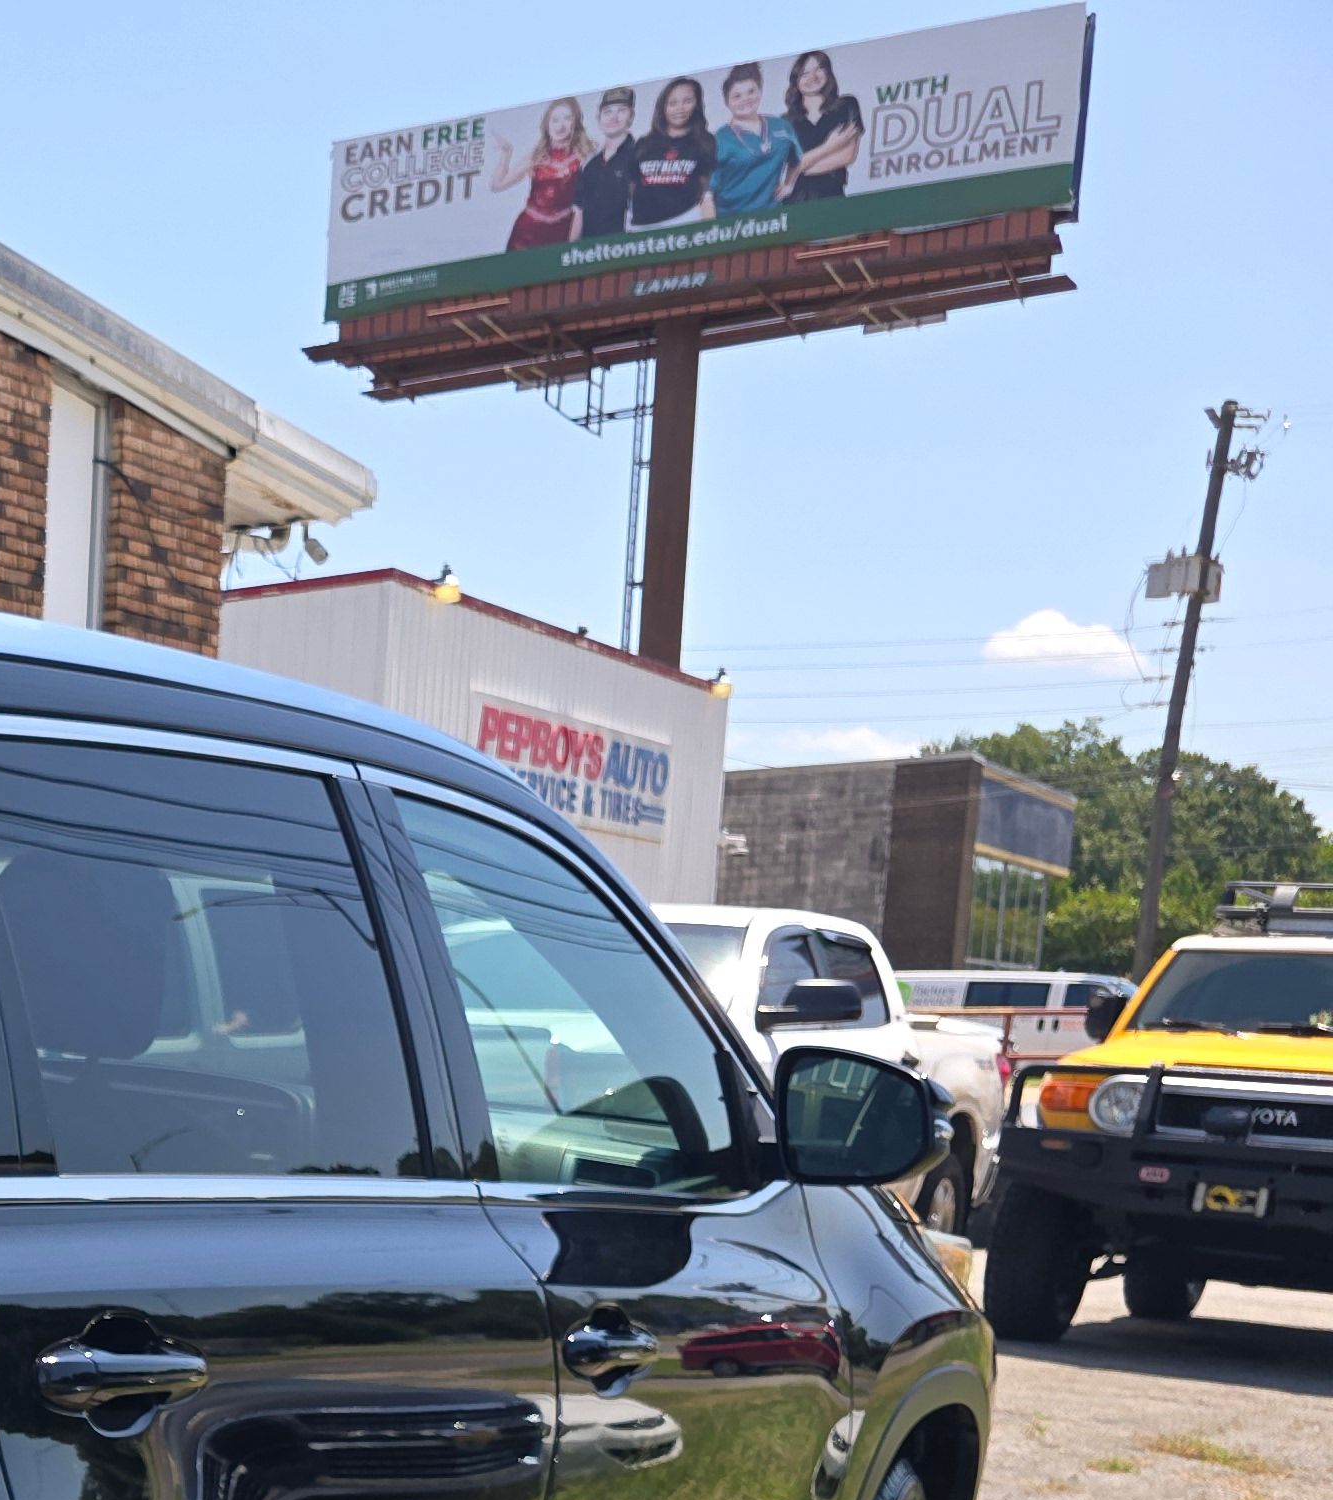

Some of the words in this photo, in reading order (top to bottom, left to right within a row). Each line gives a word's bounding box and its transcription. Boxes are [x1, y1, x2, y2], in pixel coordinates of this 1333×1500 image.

[875, 73, 950, 105] WITH
[345, 131, 414, 166] EARN
[422, 117, 485, 149] FREE
[869, 79, 1061, 158] DUAL
[340, 141, 485, 193] COLLEGE
[868, 131, 1059, 180] ENROLLMENT
[340, 169, 480, 223] CREDIT
[561, 213, 788, 267] sheltonstate.edu/dual
[634, 272, 709, 297] LAMAR
[477, 705, 604, 781] PEPBOYS
[603, 740, 669, 797] AUTO
[510, 766, 578, 814] RVICE
[1252, 1106, 1298, 1128] YOTA
